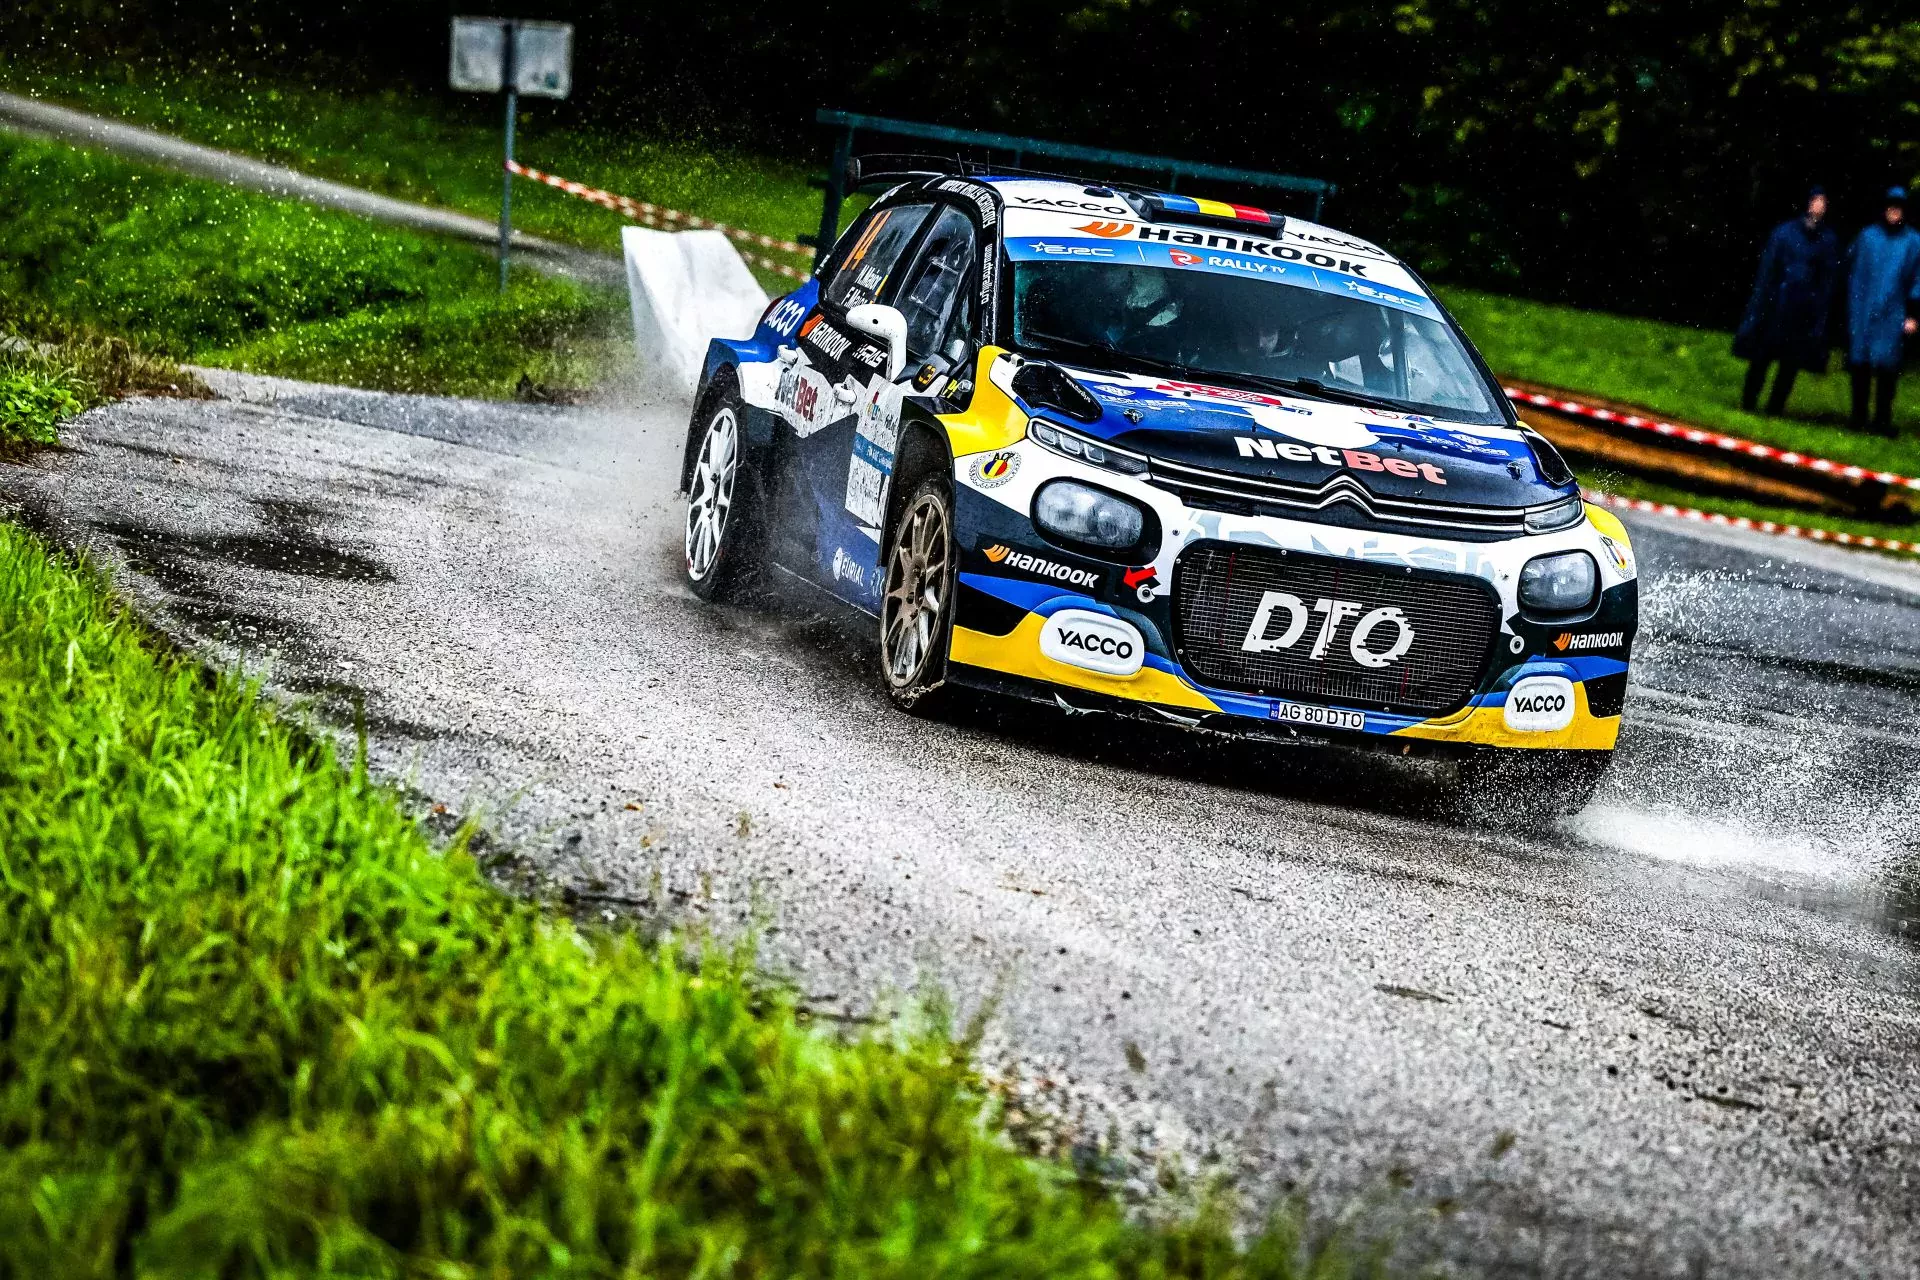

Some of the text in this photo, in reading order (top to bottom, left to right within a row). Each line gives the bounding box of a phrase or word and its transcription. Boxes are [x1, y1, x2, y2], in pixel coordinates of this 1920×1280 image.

[1014, 196, 1127, 215] YACCO
[841, 210, 893, 271] 14
[1037, 244, 1116, 258] ERC
[1283, 230, 1386, 256] YACCO
[1354, 285, 1424, 311] ERC
[763, 299, 806, 338] ACCO
[1234, 436, 1447, 485] NetBet
[1241, 590, 1415, 668] DTO
[1057, 627, 1133, 660] YACCO
[1280, 704, 1362, 728] AG 80 DTO
[1514, 695, 1566, 713] YACCO
